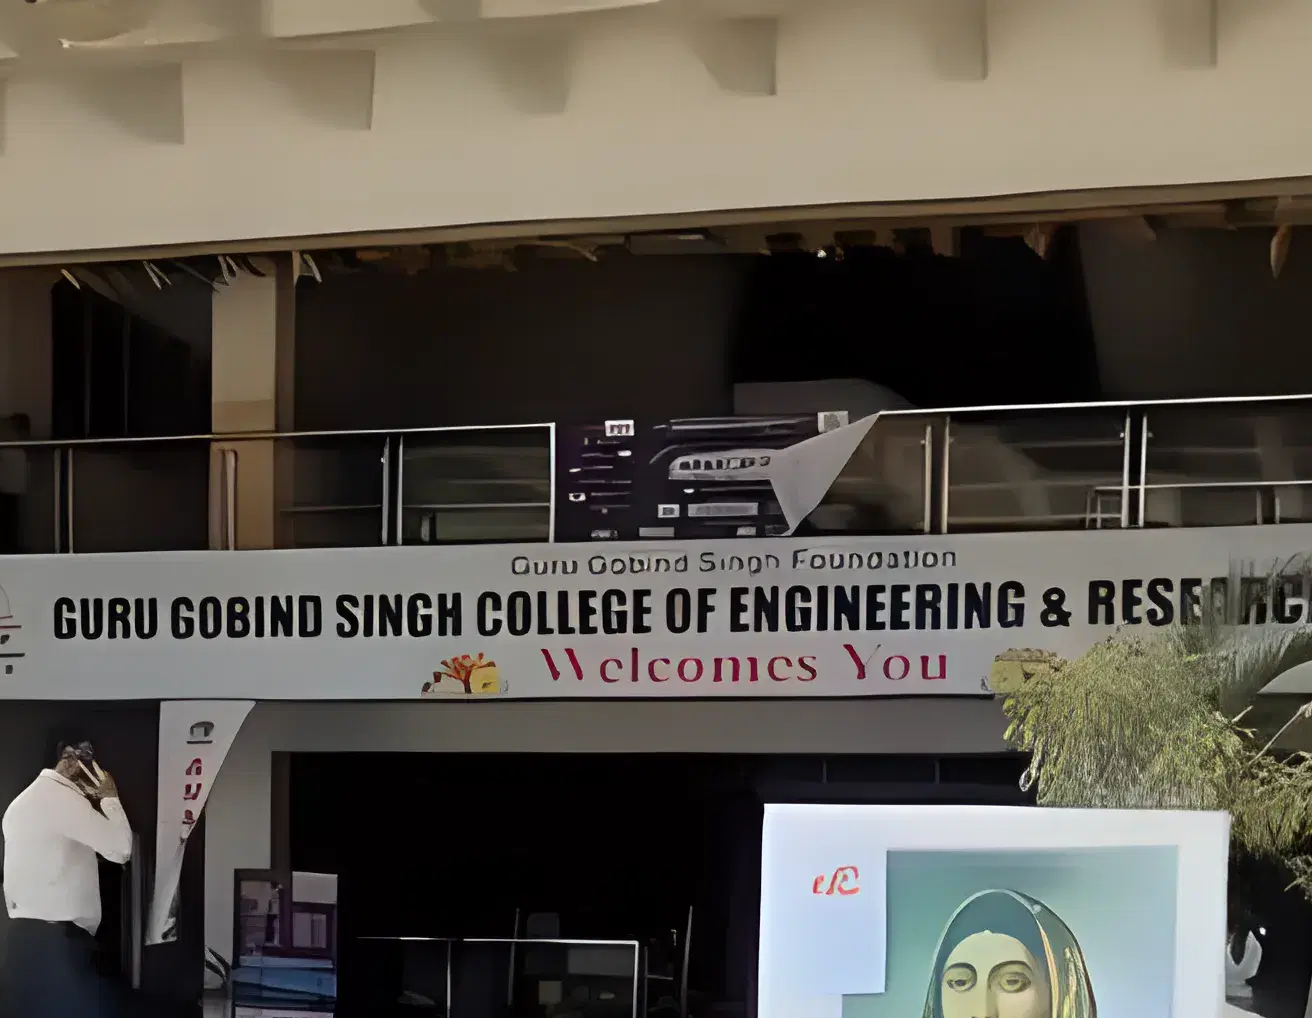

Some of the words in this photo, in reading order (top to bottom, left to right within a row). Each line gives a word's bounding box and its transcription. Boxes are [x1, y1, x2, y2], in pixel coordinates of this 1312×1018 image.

[53, 597, 158, 640] GURU
[171, 595, 323, 639] GOBIND
[335, 591, 463, 639] SINGH
[476, 588, 653, 637] COLLEGE
[665, 587, 718, 634] OF
[729, 581, 1026, 633] ENGINEERING
[1039, 586, 1073, 627] &
[540, 646, 818, 684] Welcomes
[842, 643, 948, 681] You
